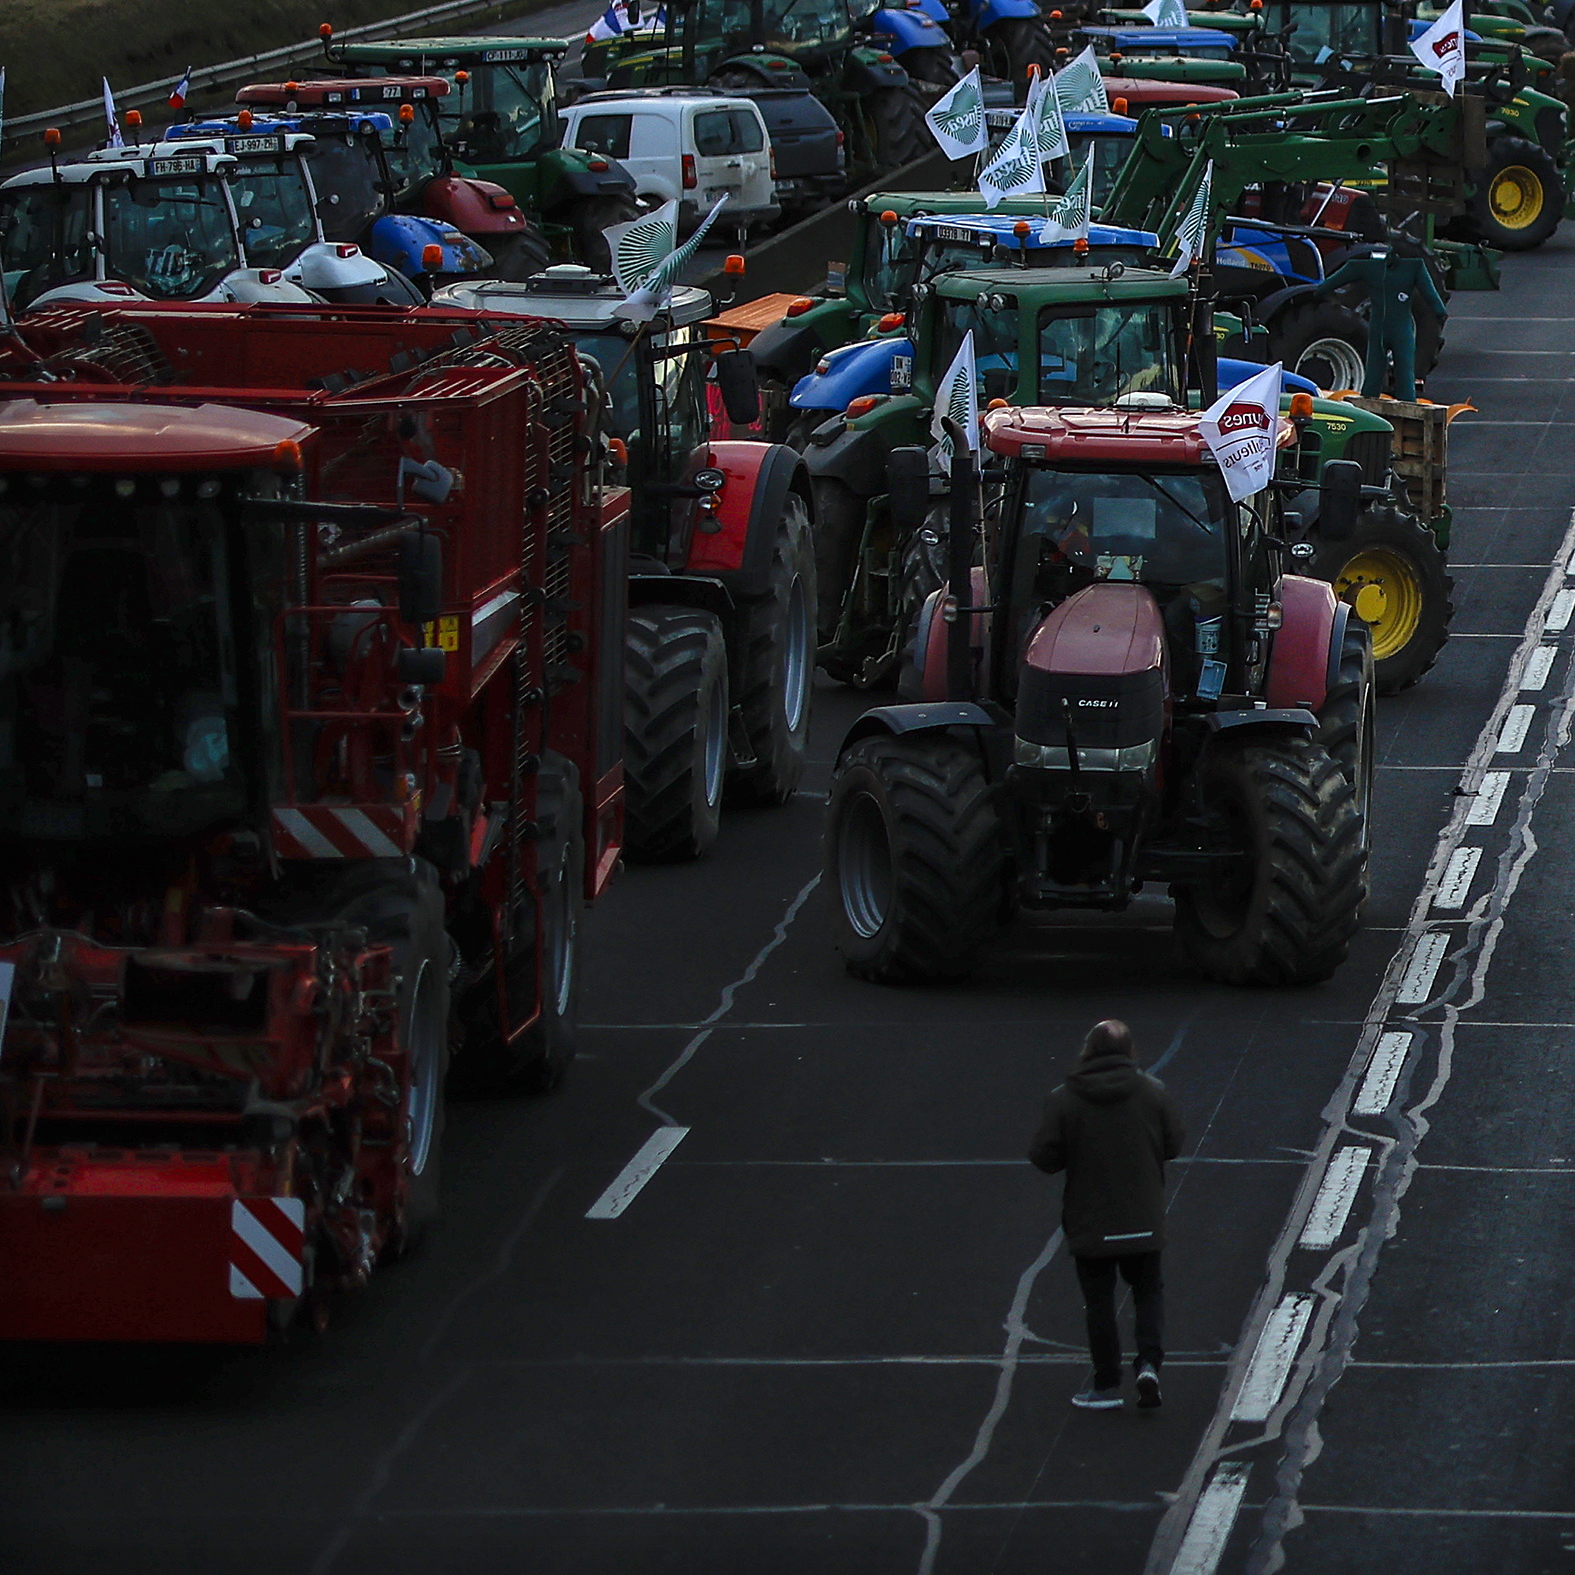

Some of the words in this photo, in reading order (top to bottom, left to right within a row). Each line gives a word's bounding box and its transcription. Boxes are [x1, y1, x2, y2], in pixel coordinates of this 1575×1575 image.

[154, 158, 196, 174] FH-796-HA
[1216, 256, 1246, 266] Holland
[1326, 422, 1347, 432] 7530
[1078, 699, 1107, 708] CASE
